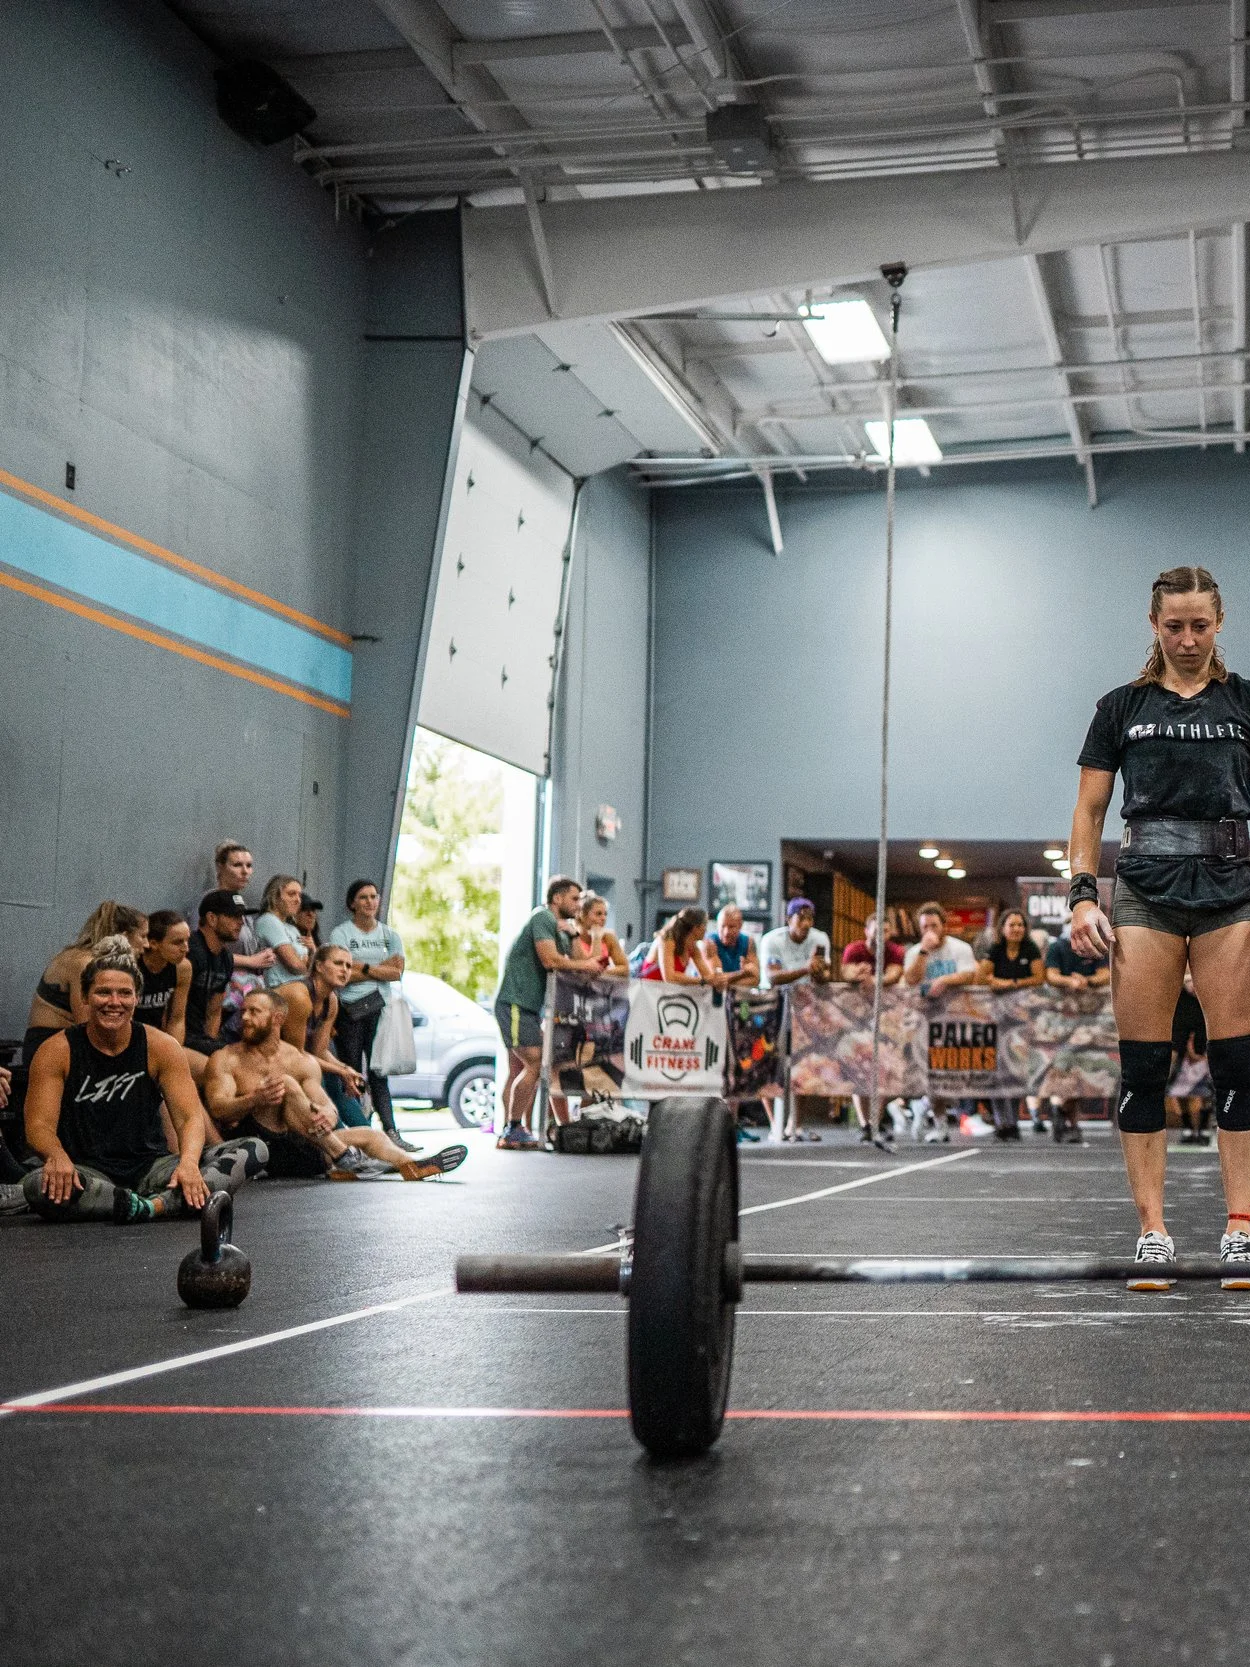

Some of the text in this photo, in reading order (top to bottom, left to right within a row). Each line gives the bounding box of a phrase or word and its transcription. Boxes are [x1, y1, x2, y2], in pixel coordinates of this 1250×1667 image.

[652, 1036, 696, 1050] CRANE
[929, 1022, 997, 1047] PALEO
[646, 1056, 700, 1071] FITNESS
[928, 1047, 997, 1071] WORKS
[74, 1071, 146, 1103] LIFT
[1223, 1089, 1236, 1113] ROGUE
